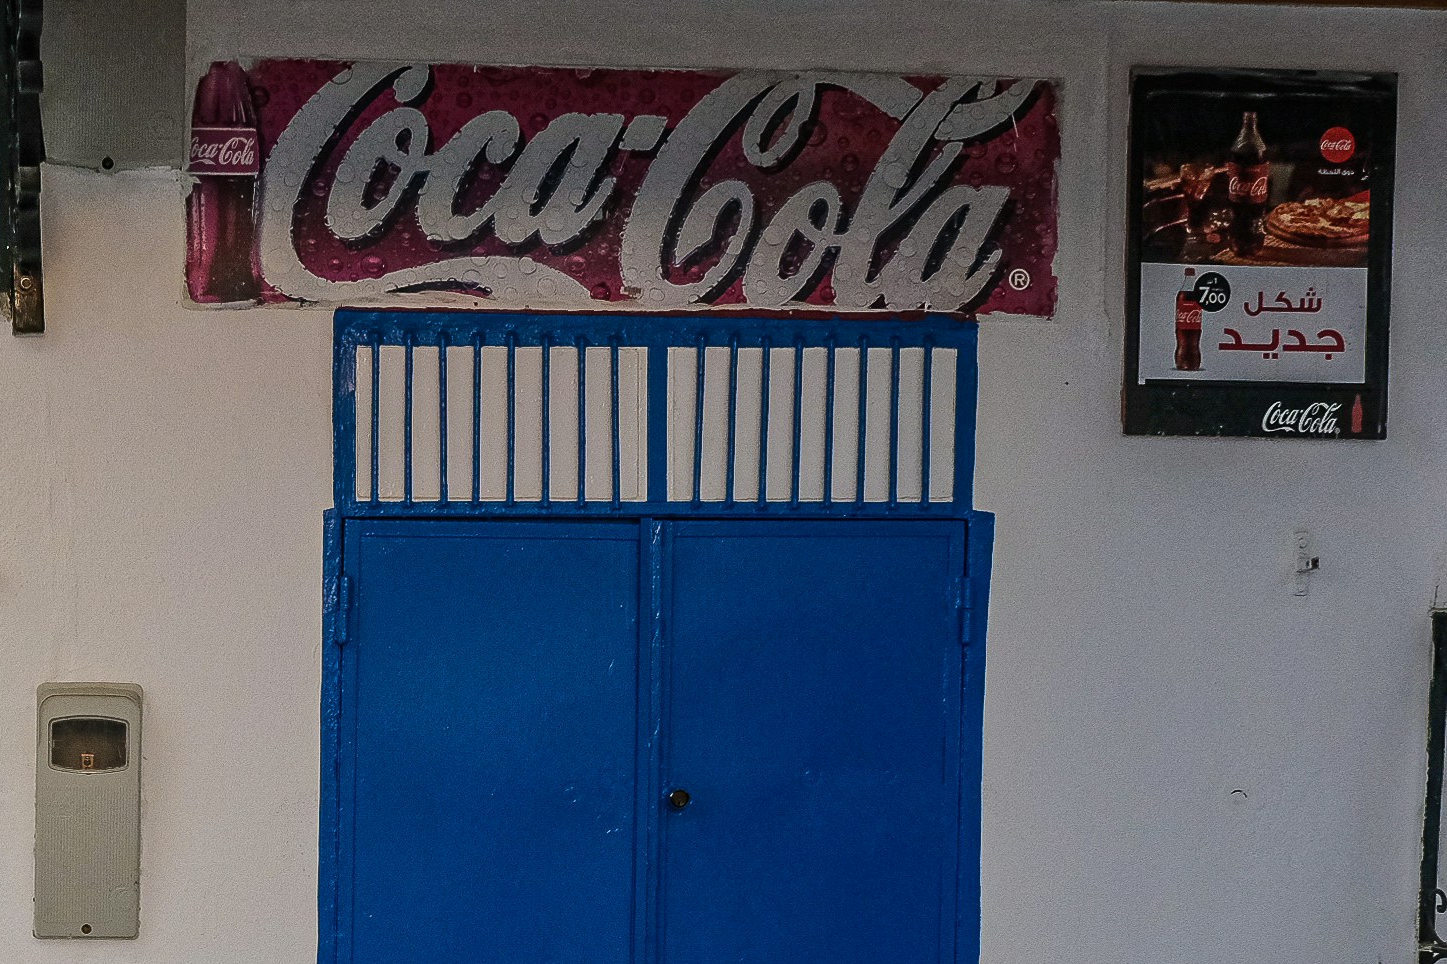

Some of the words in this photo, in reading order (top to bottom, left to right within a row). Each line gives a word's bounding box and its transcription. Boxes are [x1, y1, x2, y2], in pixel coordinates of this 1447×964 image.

[260, 63, 1037, 311] Coca-Cola
[1199, 286, 1226, 305] 7,00
[1243, 287, 1323, 316] شكل
[1218, 327, 1346, 360] جديد
[1261, 401, 1342, 434] Coca-Cola
